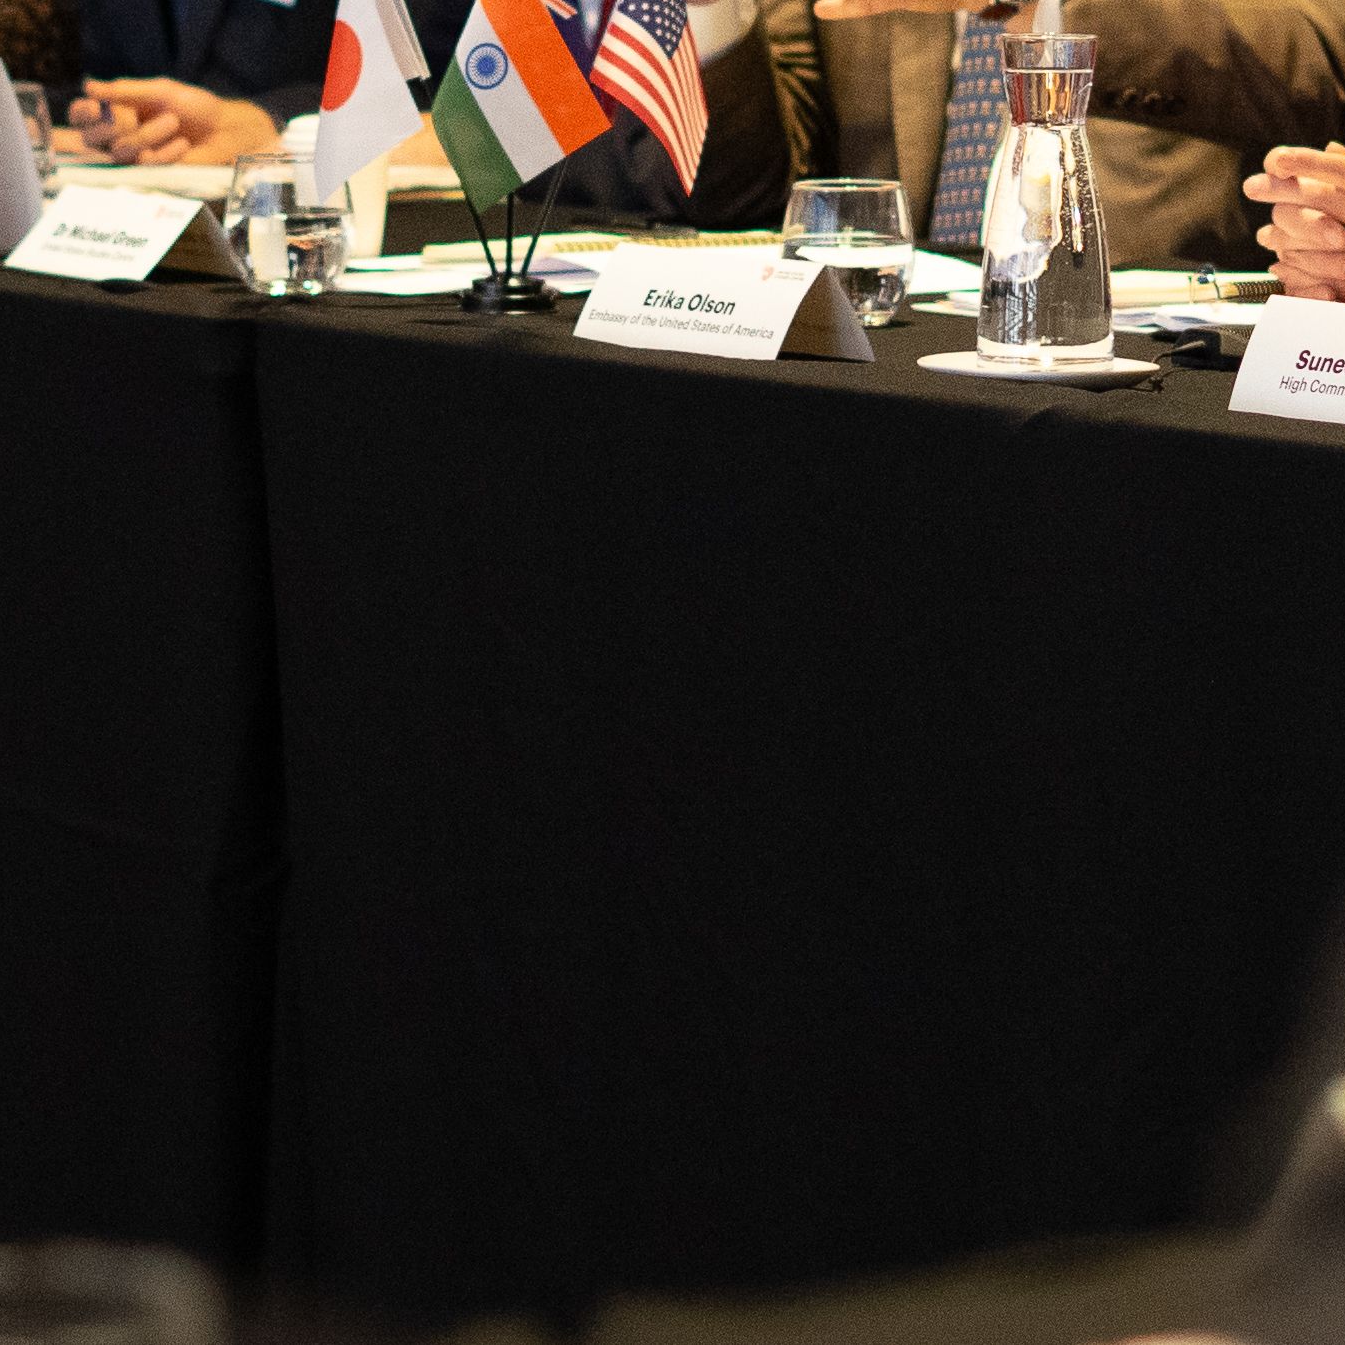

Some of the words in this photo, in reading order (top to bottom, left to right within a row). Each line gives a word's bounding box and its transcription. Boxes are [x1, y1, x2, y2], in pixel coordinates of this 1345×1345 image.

[643, 289, 685, 310] Erika
[688, 293, 736, 316] Olson
[588, 308, 628, 326] Embassy
[630, 313, 643, 325] of
[642, 314, 657, 327] the
[659, 316, 691, 330] United
[691, 319, 721, 334] States
[722, 323, 735, 335] of
[733, 324, 775, 340] America
[1279, 375, 1308, 395] High
